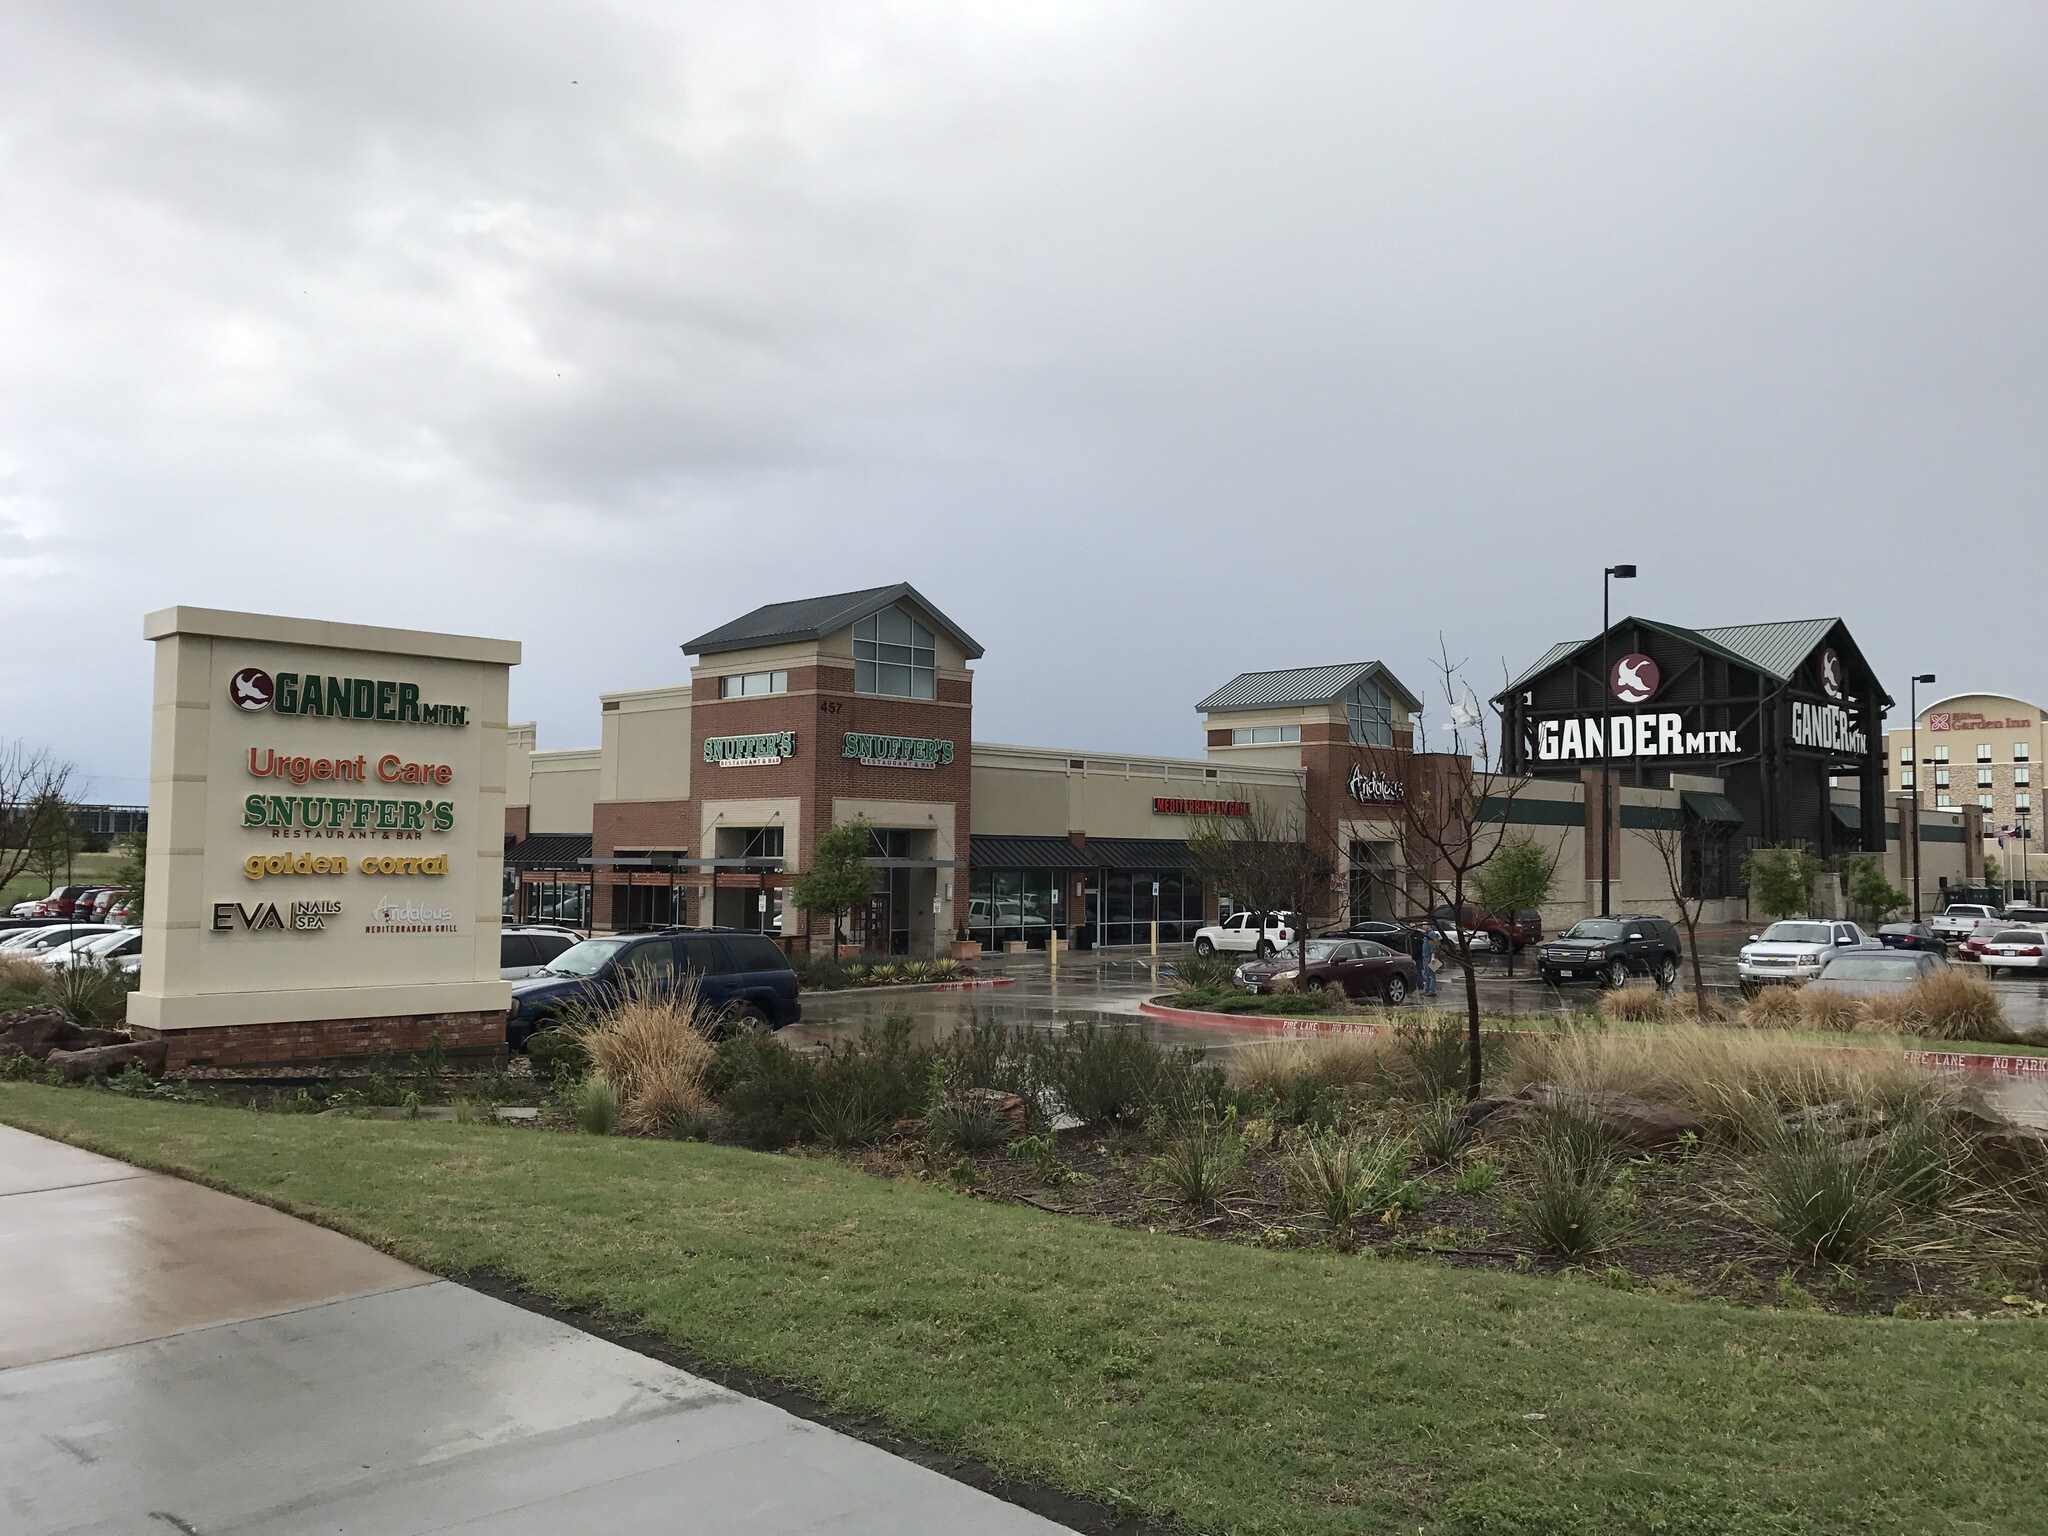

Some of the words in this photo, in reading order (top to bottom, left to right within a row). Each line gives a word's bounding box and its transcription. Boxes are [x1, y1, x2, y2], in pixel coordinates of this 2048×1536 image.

[274, 672, 421, 723] GANDER
[422, 703, 470, 726] MTN.
[820, 702, 842, 714] 457
[1952, 712, 1984, 721] Hilton
[1952, 719, 2004, 731] Garden
[2005, 717, 2031, 728] Inn
[1792, 701, 1849, 752] GANDER
[1538, 713, 1685, 760] GANDER
[1685, 730, 1742, 754] MTN.
[704, 731, 795, 762] SNUFFER'S
[842, 732, 954, 765] SNUFFER'S
[249, 747, 367, 785] Urgent
[377, 754, 453, 785] Care
[721, 758, 761, 767] RESTAURANT
[862, 759, 912, 767] RESTAURANT
[920, 761, 934, 769] BAR
[243, 794, 455, 832] SNUFFER'S
[1157, 798, 1227, 815] MEDITERRANEAN
[1229, 801, 1250, 816] GRI
[272, 829, 377, 840] RESTAURANT
[381, 831, 391, 840] &
[396, 831, 423, 841] BAR
[245, 852, 349, 880] golden
[360, 853, 449, 875] corral
[211, 902, 286, 931] EVA
[297, 900, 343, 915] NAILS
[372, 894, 453, 925] Andalous
[296, 915, 326, 930] SPA
[365, 925, 432, 934] MEDITERRANEAN
[435, 924, 458, 933] GRILL
[1282, 1021, 1298, 1031] FIRE
[1300, 1021, 1318, 1031] LANE
[1331, 1023, 1342, 1033] NO
[1903, 1052, 1929, 1064] FIRE
[1935, 1054, 1966, 1067] LANE
[1993, 1057, 2008, 1069] NO
[2015, 1058, 2048, 1072] PARK
